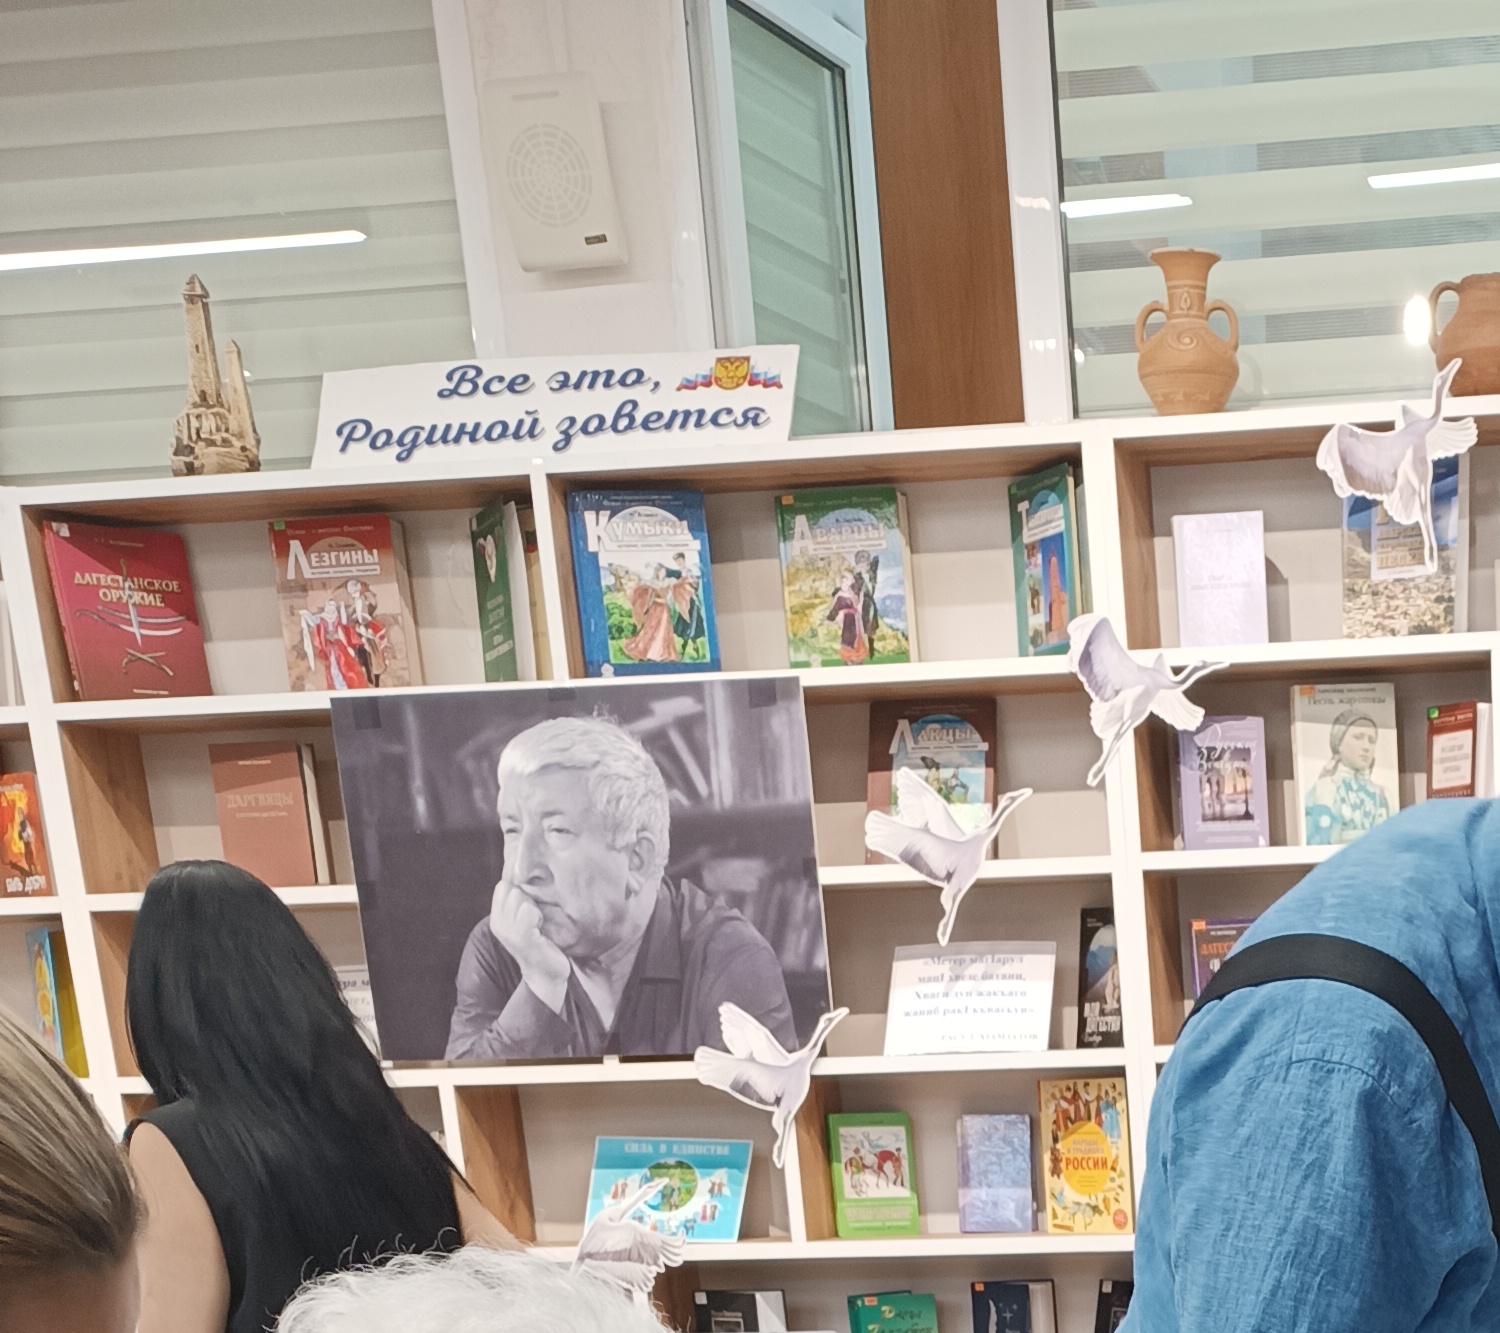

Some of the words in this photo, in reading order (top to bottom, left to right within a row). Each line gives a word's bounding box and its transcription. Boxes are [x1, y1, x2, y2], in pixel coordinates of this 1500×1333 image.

[437, 363, 534, 399] Все
[547, 367, 661, 395] это,
[336, 410, 542, 462] Родиной
[553, 399, 768, 452] зовется
[584, 510, 688, 552] КУМЫКИ
[791, 514, 885, 556] АВАРЦЫ
[287, 540, 379, 579] ЛЕЗГИНЫ
[74, 571, 181, 593] ДАГЕСТАНСКОЕ
[99, 588, 165, 607] ОРУЖИЕ
[889, 719, 973, 754] ЛАКЦЫ
[227, 792, 293, 809] ДАРГИНЦЫ
[624, 1143, 653, 1154] СИЛА
[672, 1144, 730, 1155] ЕДИНСТВЕ
[1065, 1156, 1108, 1171] РОССИИ
